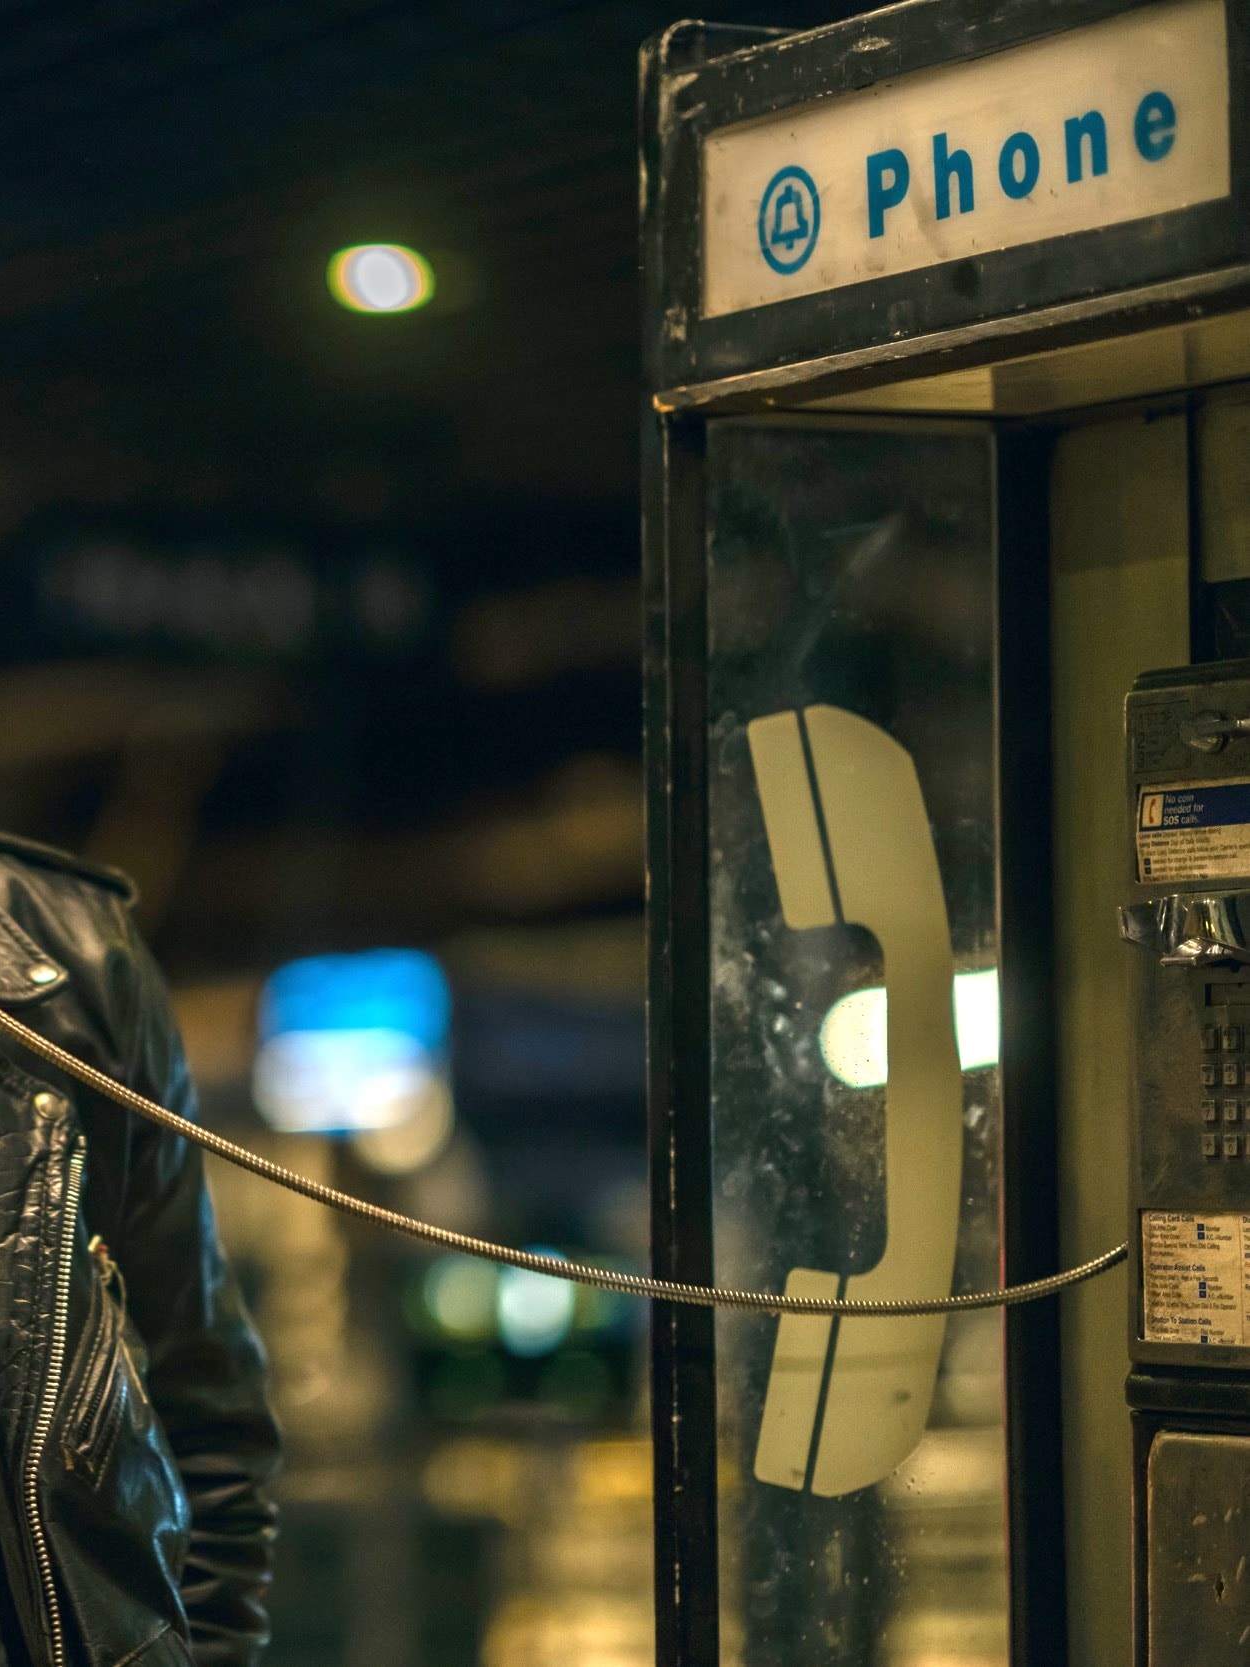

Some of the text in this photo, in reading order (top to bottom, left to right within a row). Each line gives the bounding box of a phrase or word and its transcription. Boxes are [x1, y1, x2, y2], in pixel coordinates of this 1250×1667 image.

[866, 91, 1176, 238] Phone
[1165, 794, 1194, 803] No coin
[1164, 803, 1204, 814] needed for
[1163, 815, 1179, 826] SOS
[1167, 1214, 1180, 1222] Card
[1181, 1214, 1195, 1223] Calls
[1192, 1263, 1206, 1272] Calls
[1178, 1317, 1197, 1325] Station
[1198, 1317, 1212, 1326] Calls
